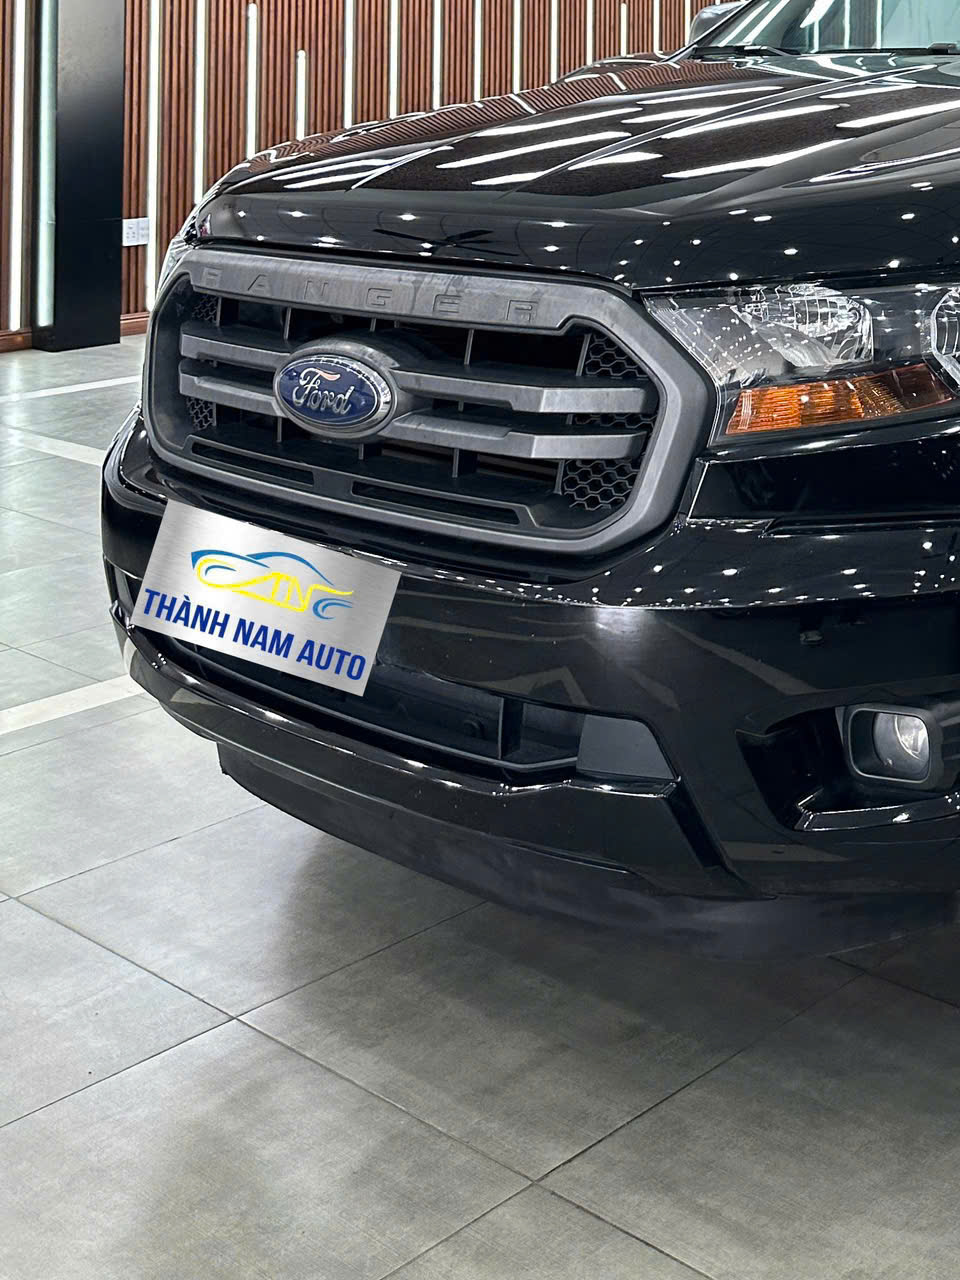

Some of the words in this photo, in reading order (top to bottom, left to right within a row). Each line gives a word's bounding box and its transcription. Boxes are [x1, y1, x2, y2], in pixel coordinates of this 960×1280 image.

[200, 267, 540, 321] RANGER
[292, 367, 355, 416] Ford
[143, 588, 230, 638] THÀNH
[232, 617, 294, 658] NAM
[296, 640, 367, 681] AUTO
